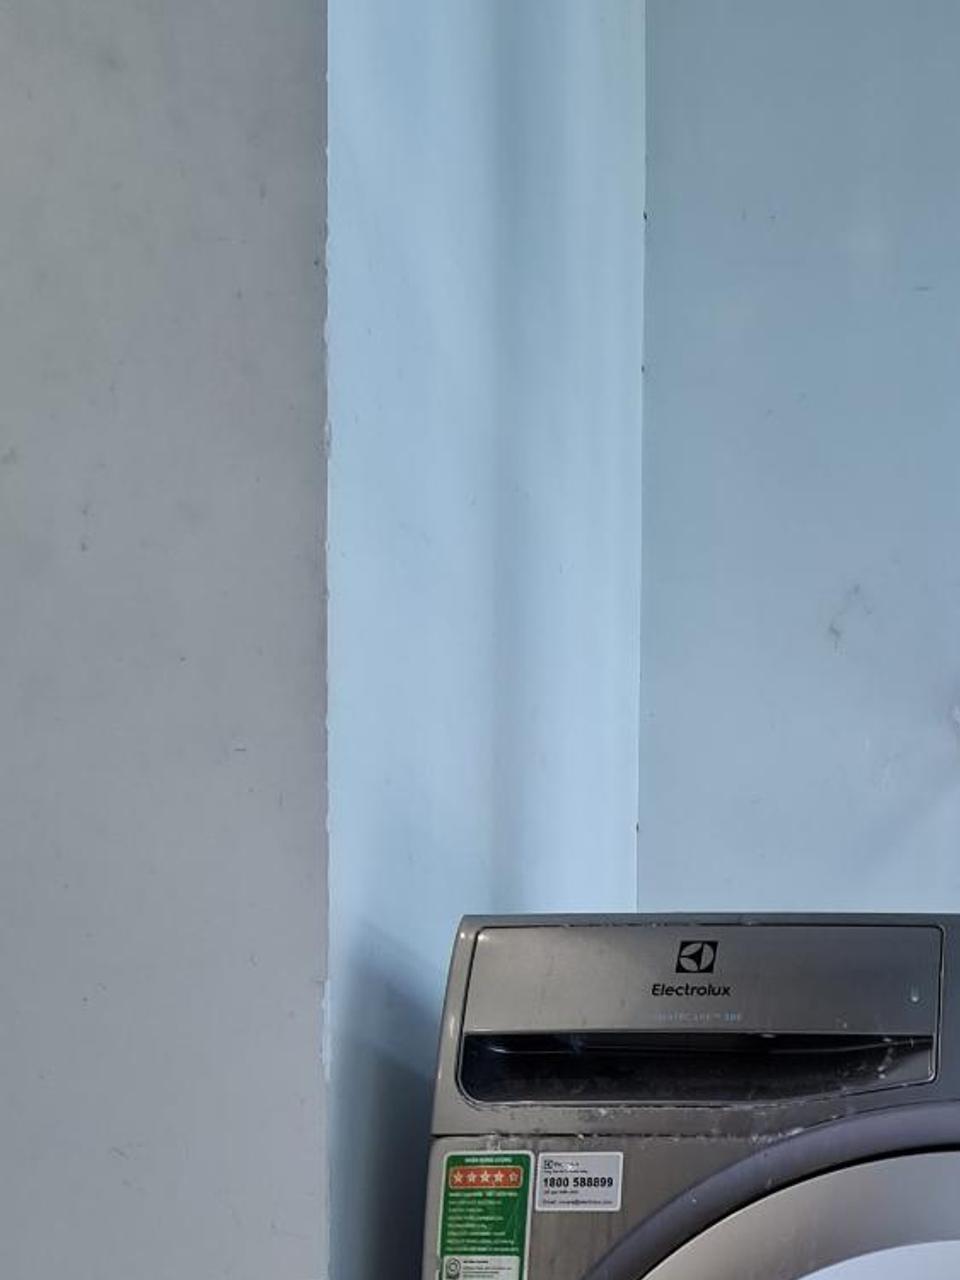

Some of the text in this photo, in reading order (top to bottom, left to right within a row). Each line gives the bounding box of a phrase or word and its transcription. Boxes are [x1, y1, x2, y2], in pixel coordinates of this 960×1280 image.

[651, 983, 731, 997] Electrolux
[544, 1177, 614, 1188] 1800 588899
